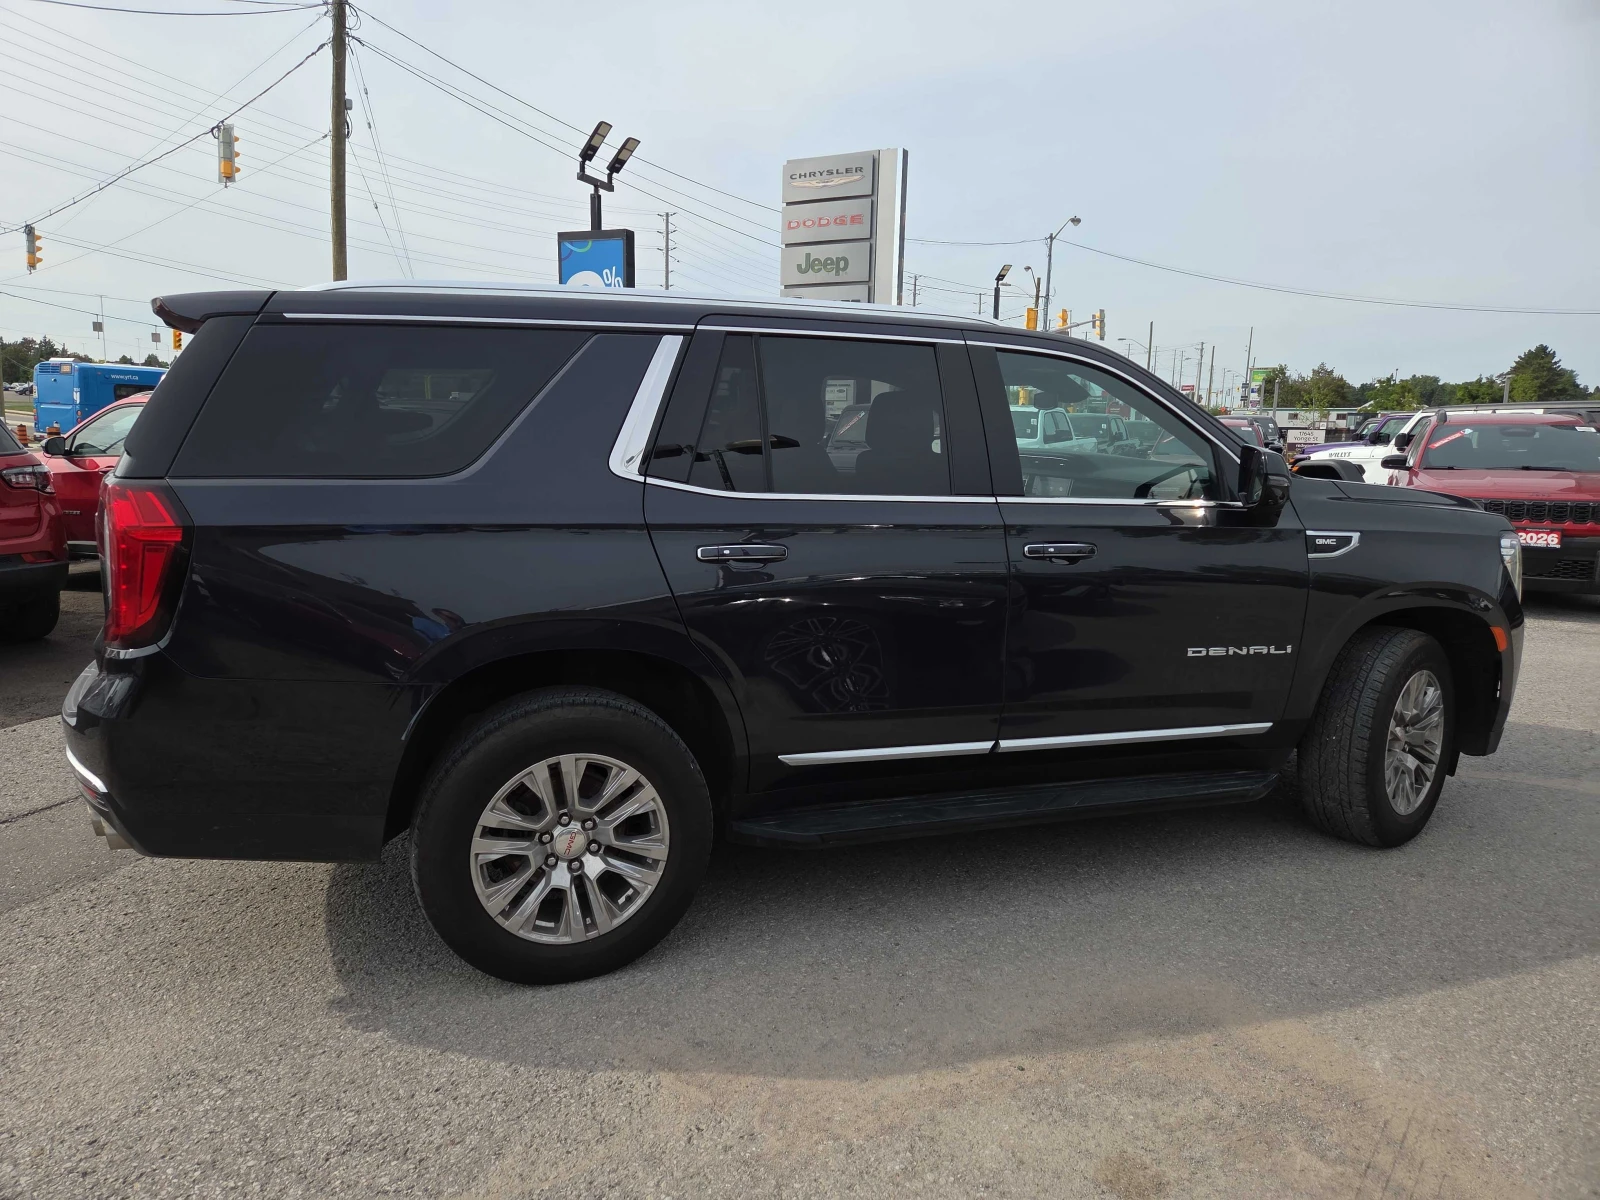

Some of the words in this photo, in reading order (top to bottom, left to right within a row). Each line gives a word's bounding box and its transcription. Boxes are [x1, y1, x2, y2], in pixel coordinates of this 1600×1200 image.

[789, 166, 864, 180] CHRYSLER
[787, 213, 864, 231] DODGE
[796, 252, 850, 276] Jeep
[1517, 532, 1559, 544] 2026
[1186, 644, 1293, 657] DENALI
[563, 831, 577, 856] GMC
